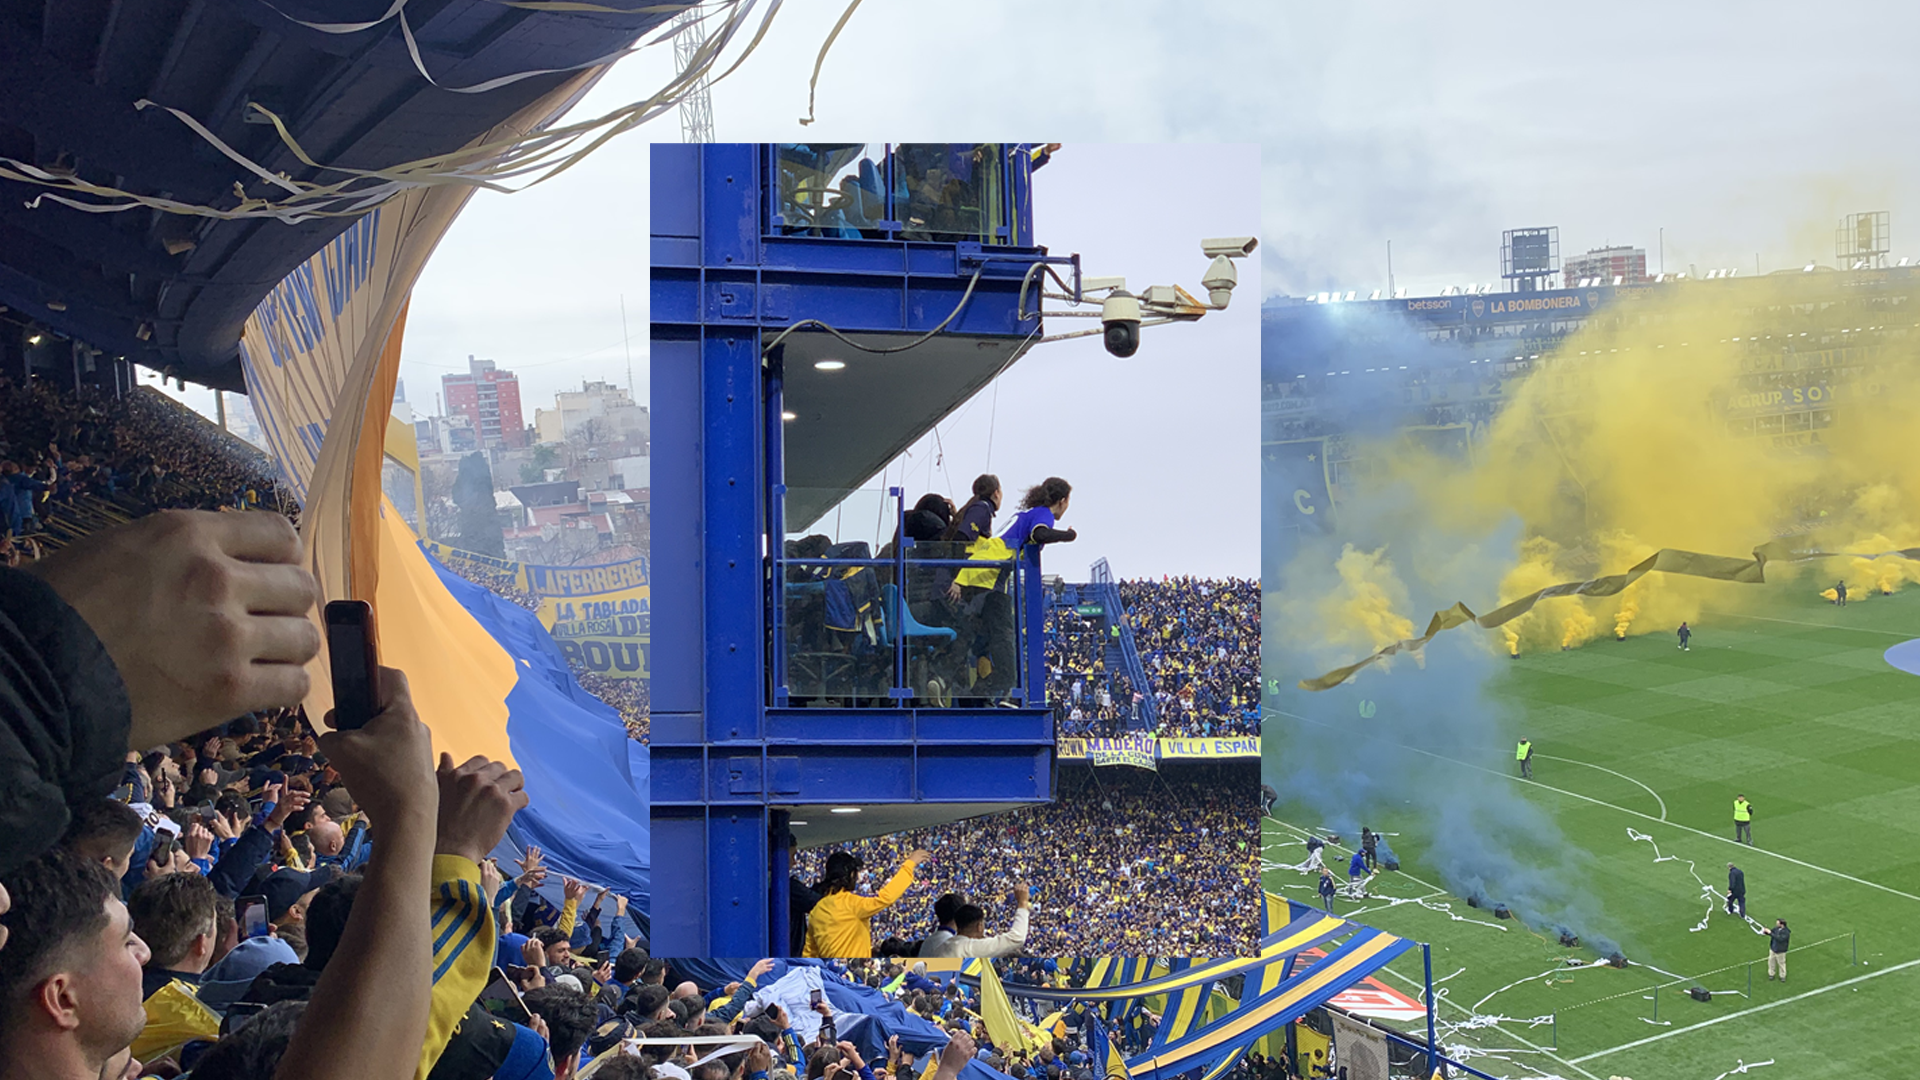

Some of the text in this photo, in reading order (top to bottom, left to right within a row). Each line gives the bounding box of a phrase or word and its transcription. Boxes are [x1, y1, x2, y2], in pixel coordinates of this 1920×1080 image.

[1615, 286, 1654, 297] betsson
[1408, 299, 1451, 311] betsson
[1491, 301, 1505, 313] LA
[1508, 296, 1581, 311] BOMBONERA
[1727, 391, 1786, 410] AGRUP.
[1793, 386, 1838, 403] SOY
[528, 558, 647, 595] LAFERRERE
[556, 597, 650, 621] LA TABLADA
[587, 618, 612, 634] ROSA
[1086, 738, 1154, 754] MADERO
[1168, 736, 1261, 755] VILLA ESPAÑ
